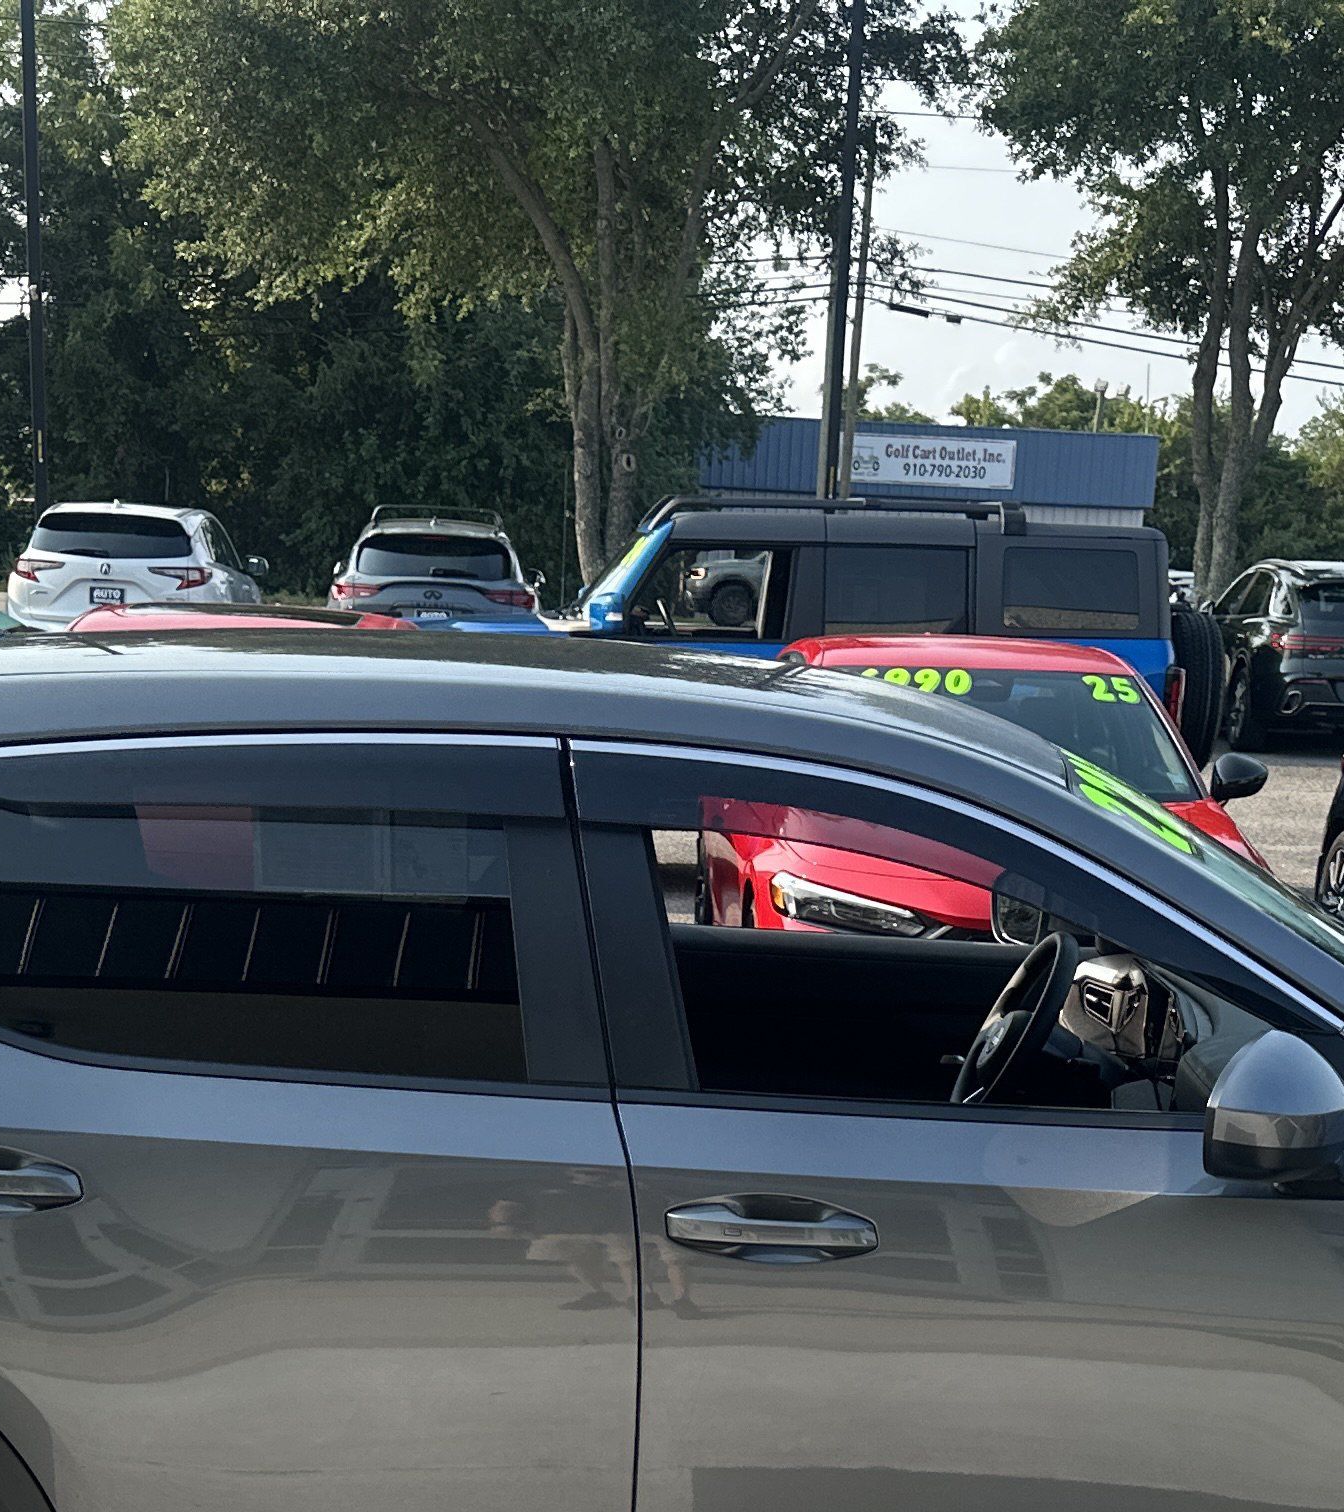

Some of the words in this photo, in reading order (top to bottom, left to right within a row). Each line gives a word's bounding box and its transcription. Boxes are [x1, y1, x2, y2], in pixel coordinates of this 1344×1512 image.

[885, 444, 910, 459] Golf
[912, 445, 937, 460] Cart
[903, 463, 987, 480] 910-790-2030
[93, 589, 122, 599] AUTO
[1081, 674, 1141, 705] 25
